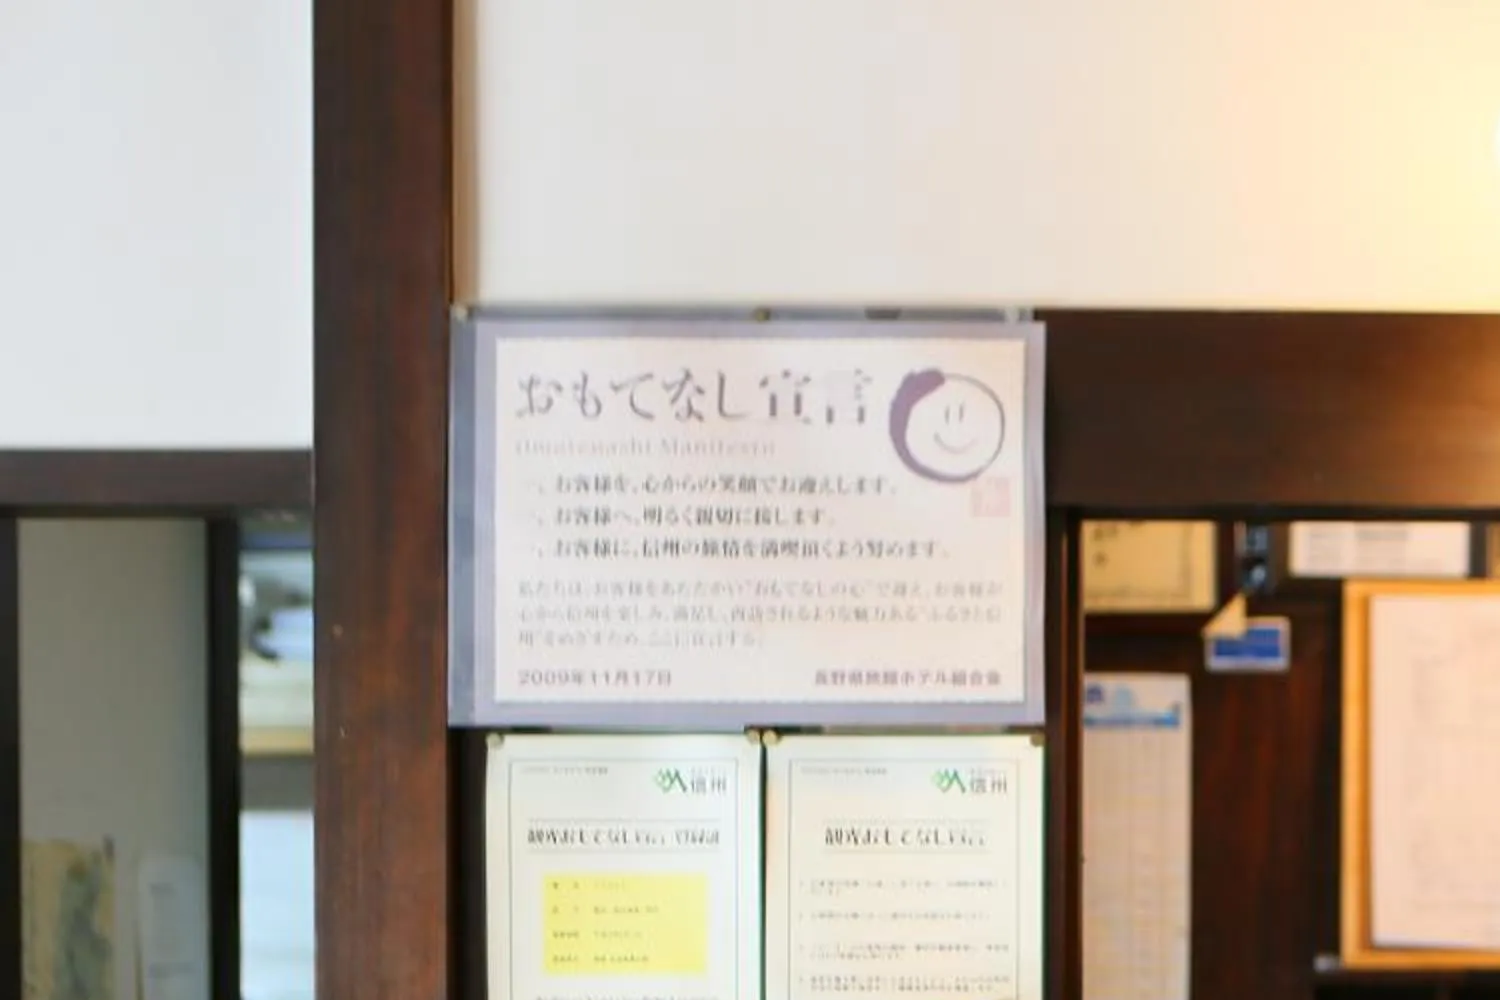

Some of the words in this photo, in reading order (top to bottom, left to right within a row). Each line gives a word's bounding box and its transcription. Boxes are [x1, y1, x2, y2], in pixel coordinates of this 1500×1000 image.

[515, 367, 873, 426] おもてなし宣言
[518, 669, 672, 687] 2009年11月17日
